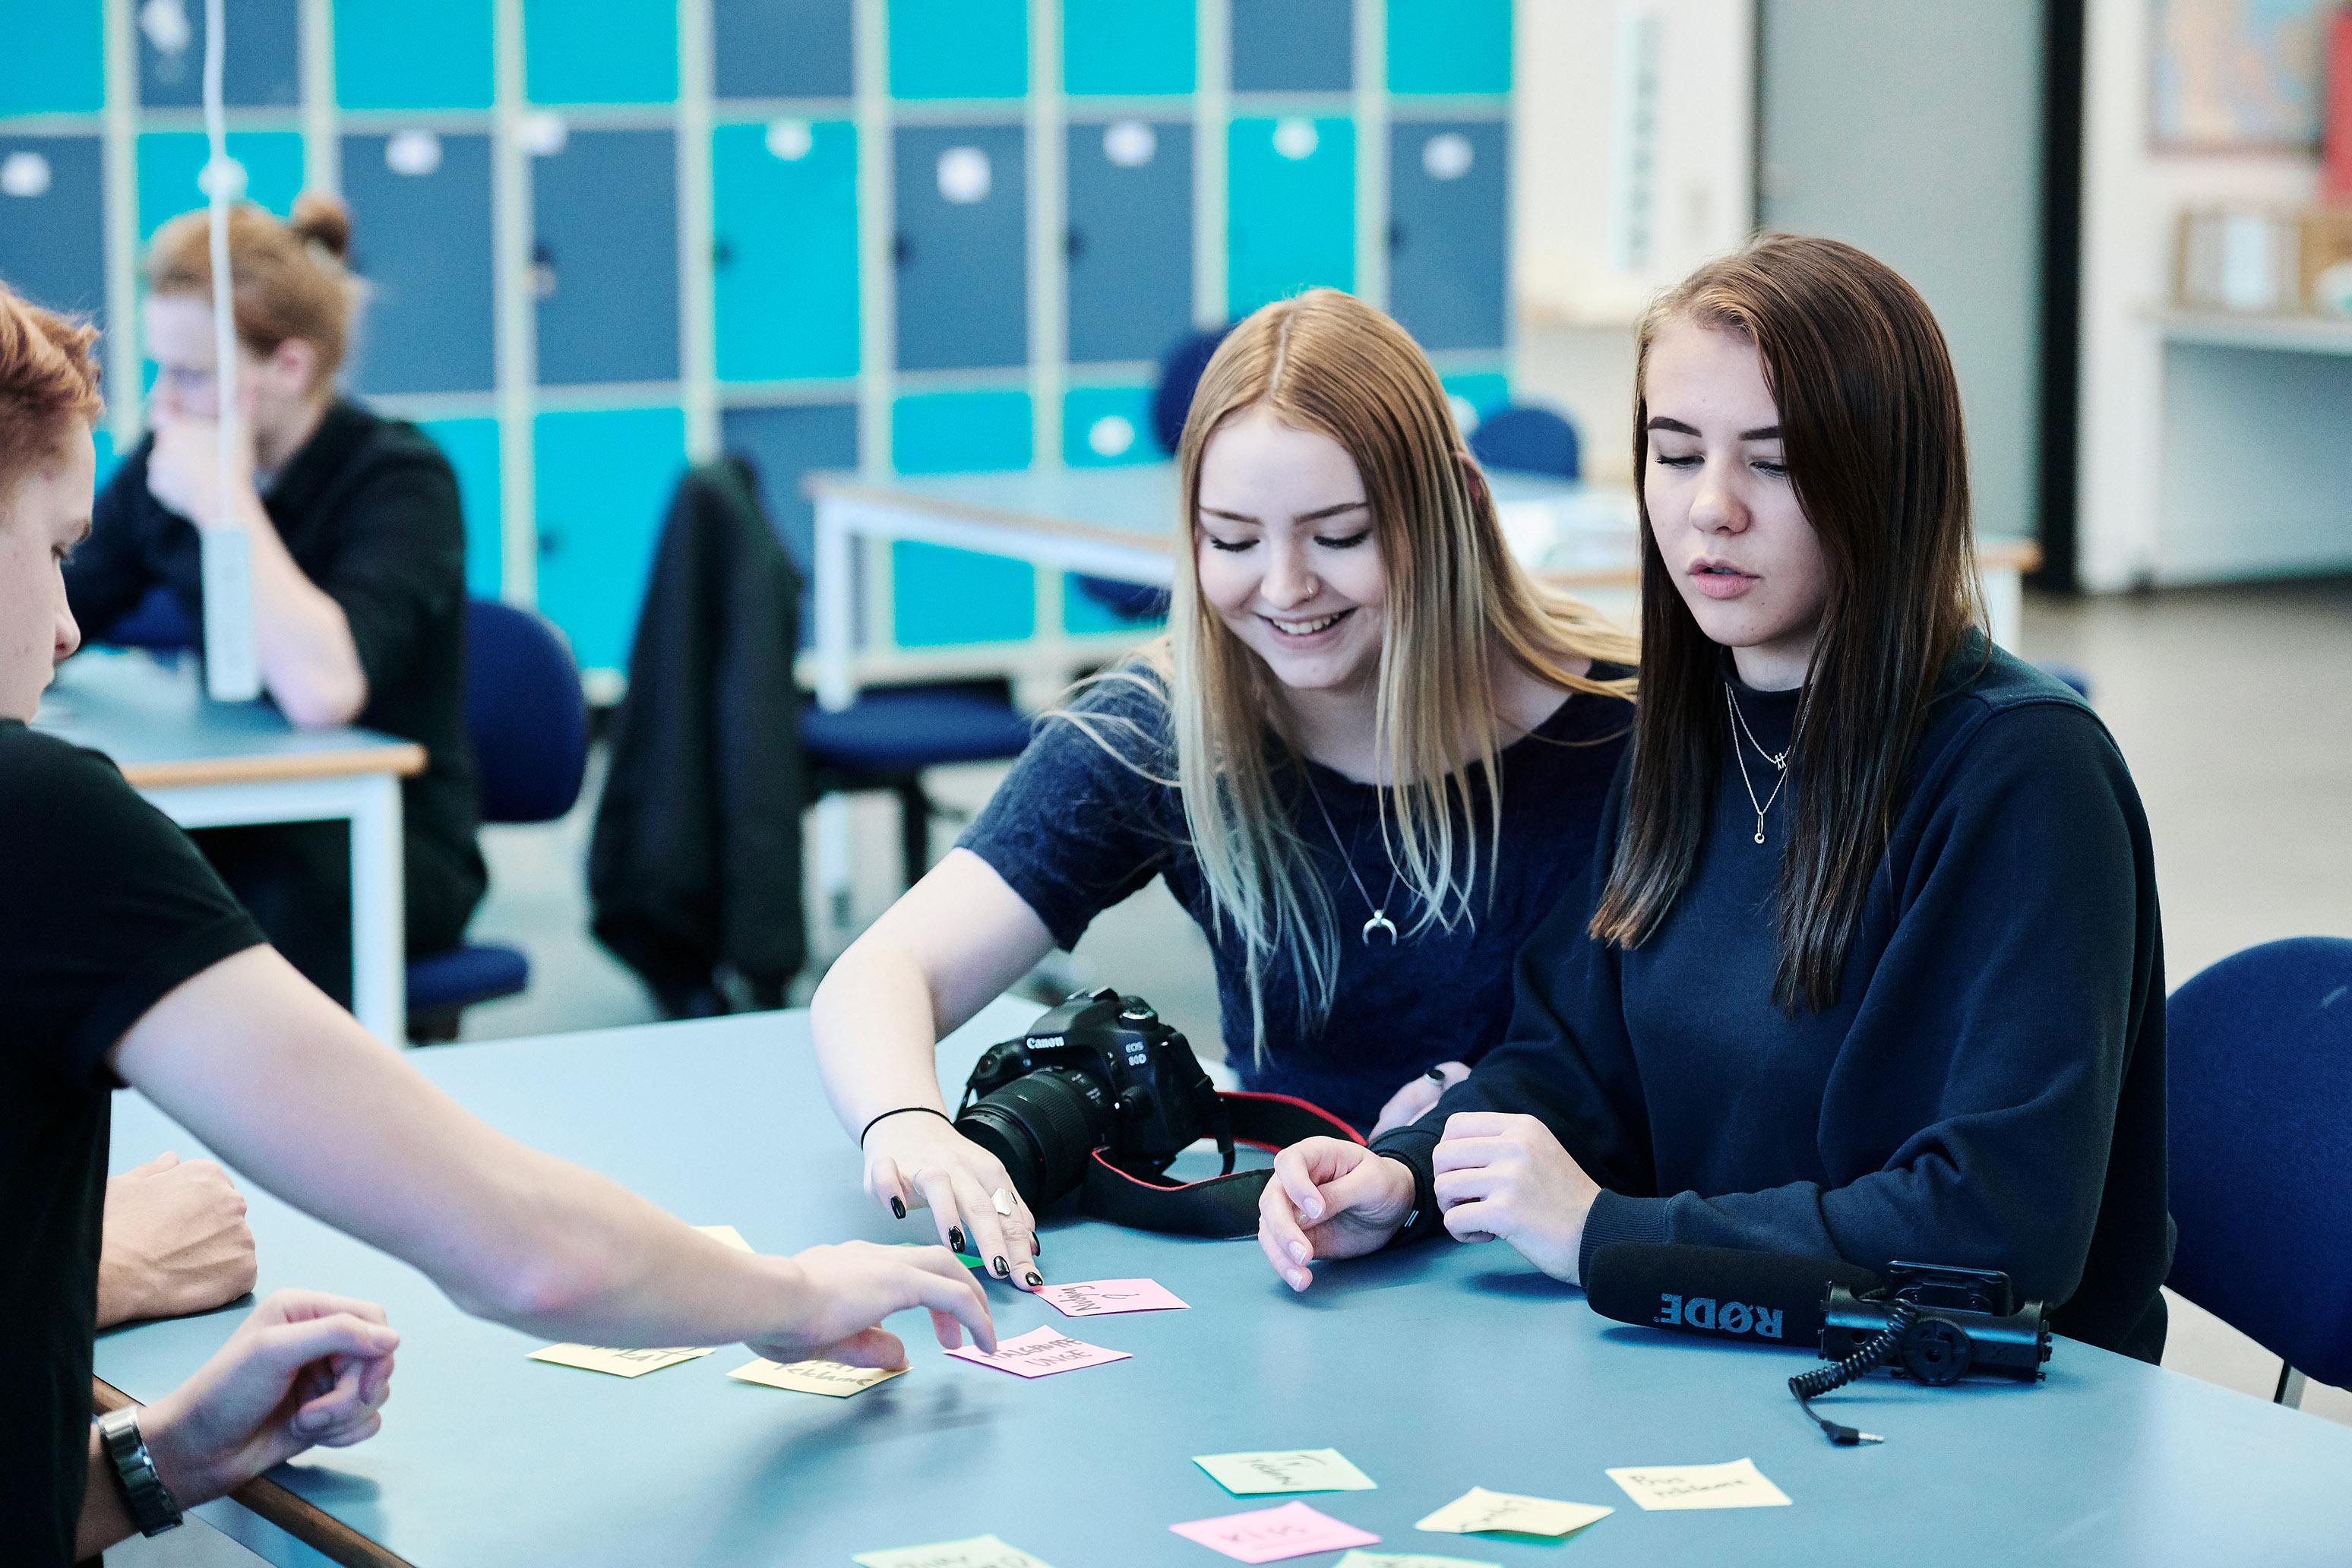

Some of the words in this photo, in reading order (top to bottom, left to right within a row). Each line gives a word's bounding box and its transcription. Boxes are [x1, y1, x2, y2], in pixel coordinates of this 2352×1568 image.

[1026, 1036, 1064, 1049] Canon
[1125, 1042, 1144, 1053] EOS
[1661, 1293, 1783, 1339] RØDE
[1024, 1349, 1092, 1367] UNGE
